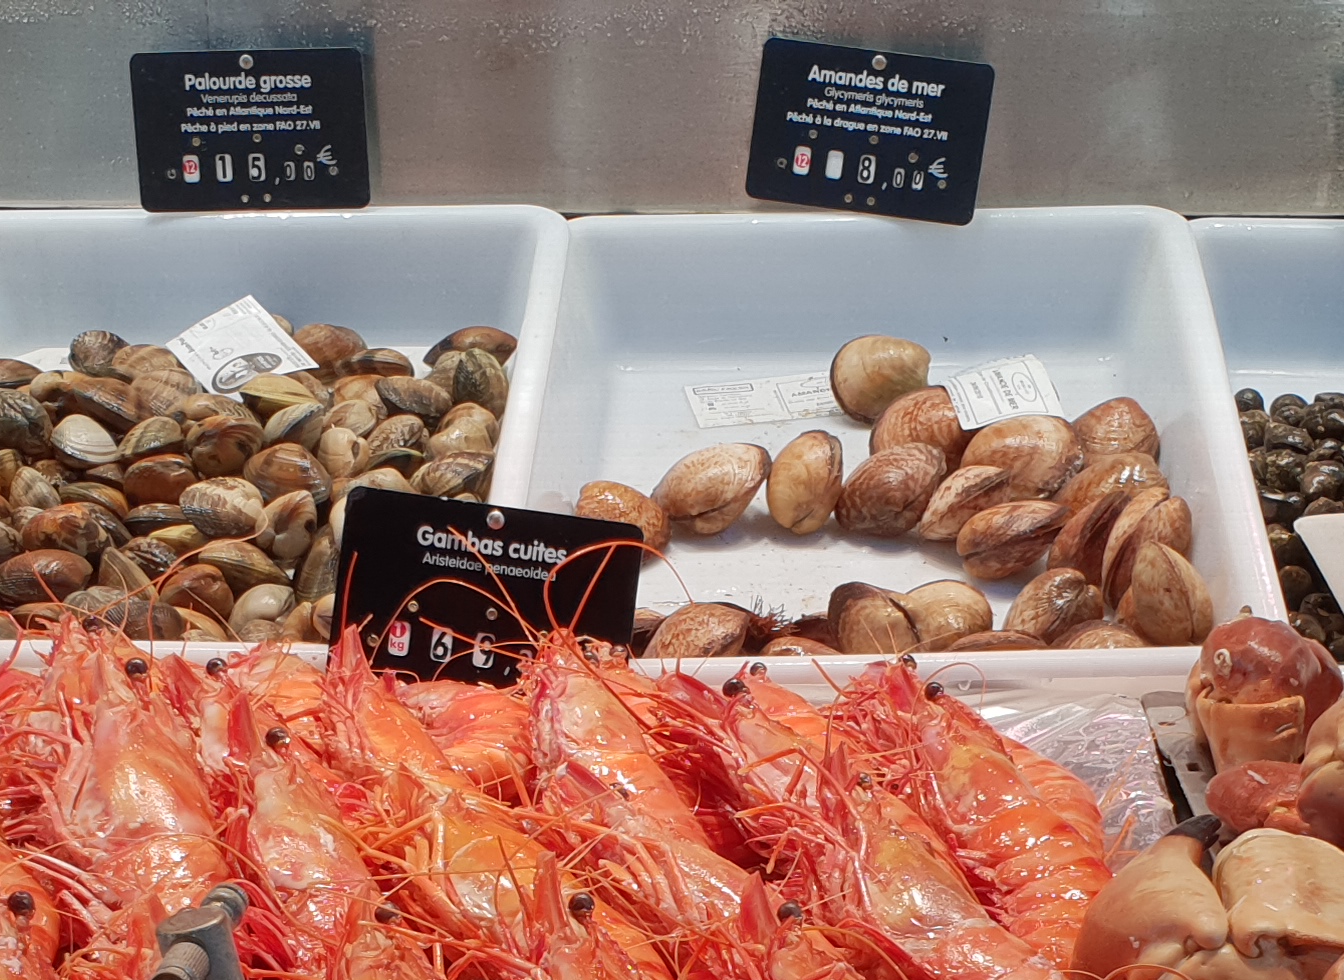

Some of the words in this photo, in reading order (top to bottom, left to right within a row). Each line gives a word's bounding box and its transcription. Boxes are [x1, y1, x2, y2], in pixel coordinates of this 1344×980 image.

[184, 72, 255, 90] Palourde
[260, 73, 311, 92] grosse
[808, 65, 883, 90] Amandes
[888, 74, 908, 93] de
[912, 82, 945, 97] mer
[201, 93, 247, 104] Venerupis
[250, 92, 297, 102] decussata
[825, 87, 874, 102] Glycymeris
[876, 94, 924, 108] glycymeris
[229, 107, 273, 117] Atlantique
[275, 105, 312, 114] Nord-Est
[836, 104, 847, 112] en
[848, 103, 893, 119] Atlantique
[895, 109, 932, 122] Nord-Est
[218, 121, 237, 133] pied
[253, 123, 274, 131] zone
[276, 121, 294, 130] FAO
[296, 120, 320, 130] 27.VII
[824, 116, 831, 126] la
[834, 118, 864, 132] drague
[866, 123, 878, 131] en
[880, 124, 901, 135] zone
[903, 127, 921, 138] FAO
[923, 129, 947, 141] 27.VII
[417, 525, 503, 558] Gambas
[509, 540, 567, 565] cuites
[422, 552, 482, 572] Aristeidae
[390, 637, 404, 651] kg
